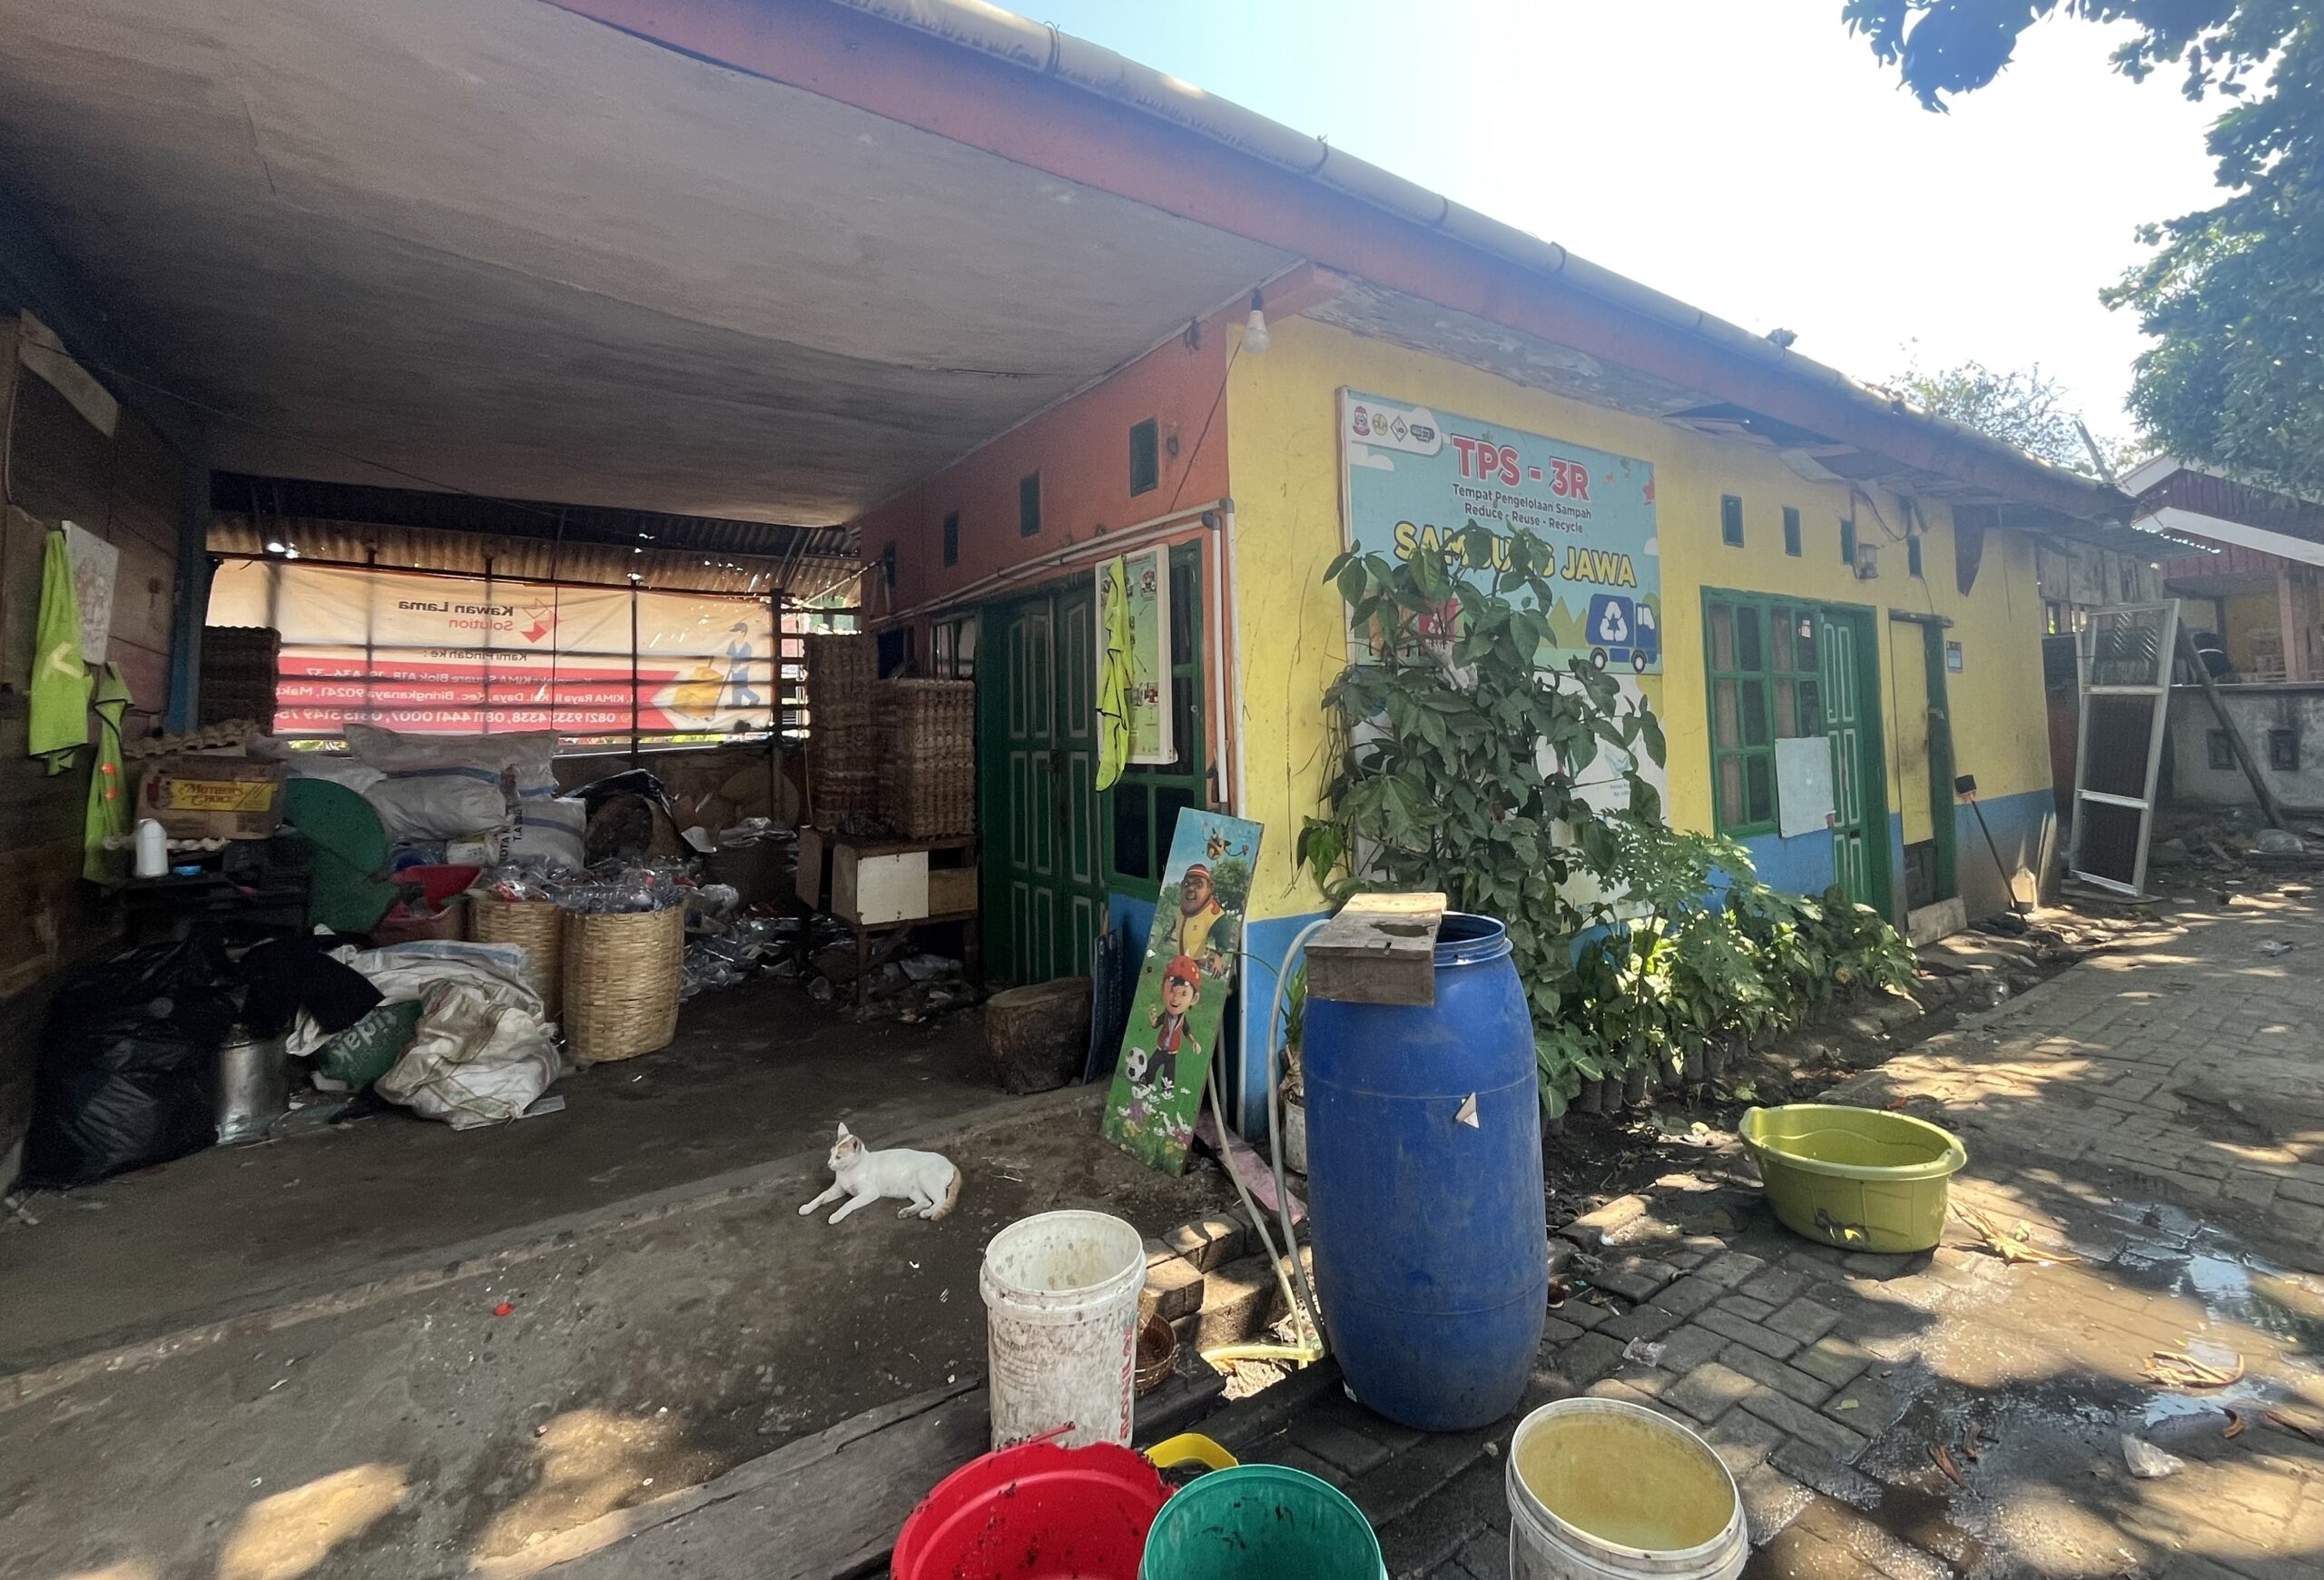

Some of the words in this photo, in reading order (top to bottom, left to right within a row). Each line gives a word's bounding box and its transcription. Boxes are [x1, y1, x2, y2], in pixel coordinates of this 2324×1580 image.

[1451, 434, 1521, 487] TPS
[1550, 456, 1590, 501] 3R
[1452, 483, 1493, 501] Tempat
[1495, 491, 1553, 511] Pengelolaan
[1556, 504, 1591, 519] Sampah
[1465, 502, 1503, 520] Reduce
[1512, 511, 1541, 525] Reuse
[1549, 518, 1583, 533] Recycle
[1393, 520, 1555, 578] SAMU
[1561, 546, 1638, 588] JAWA
